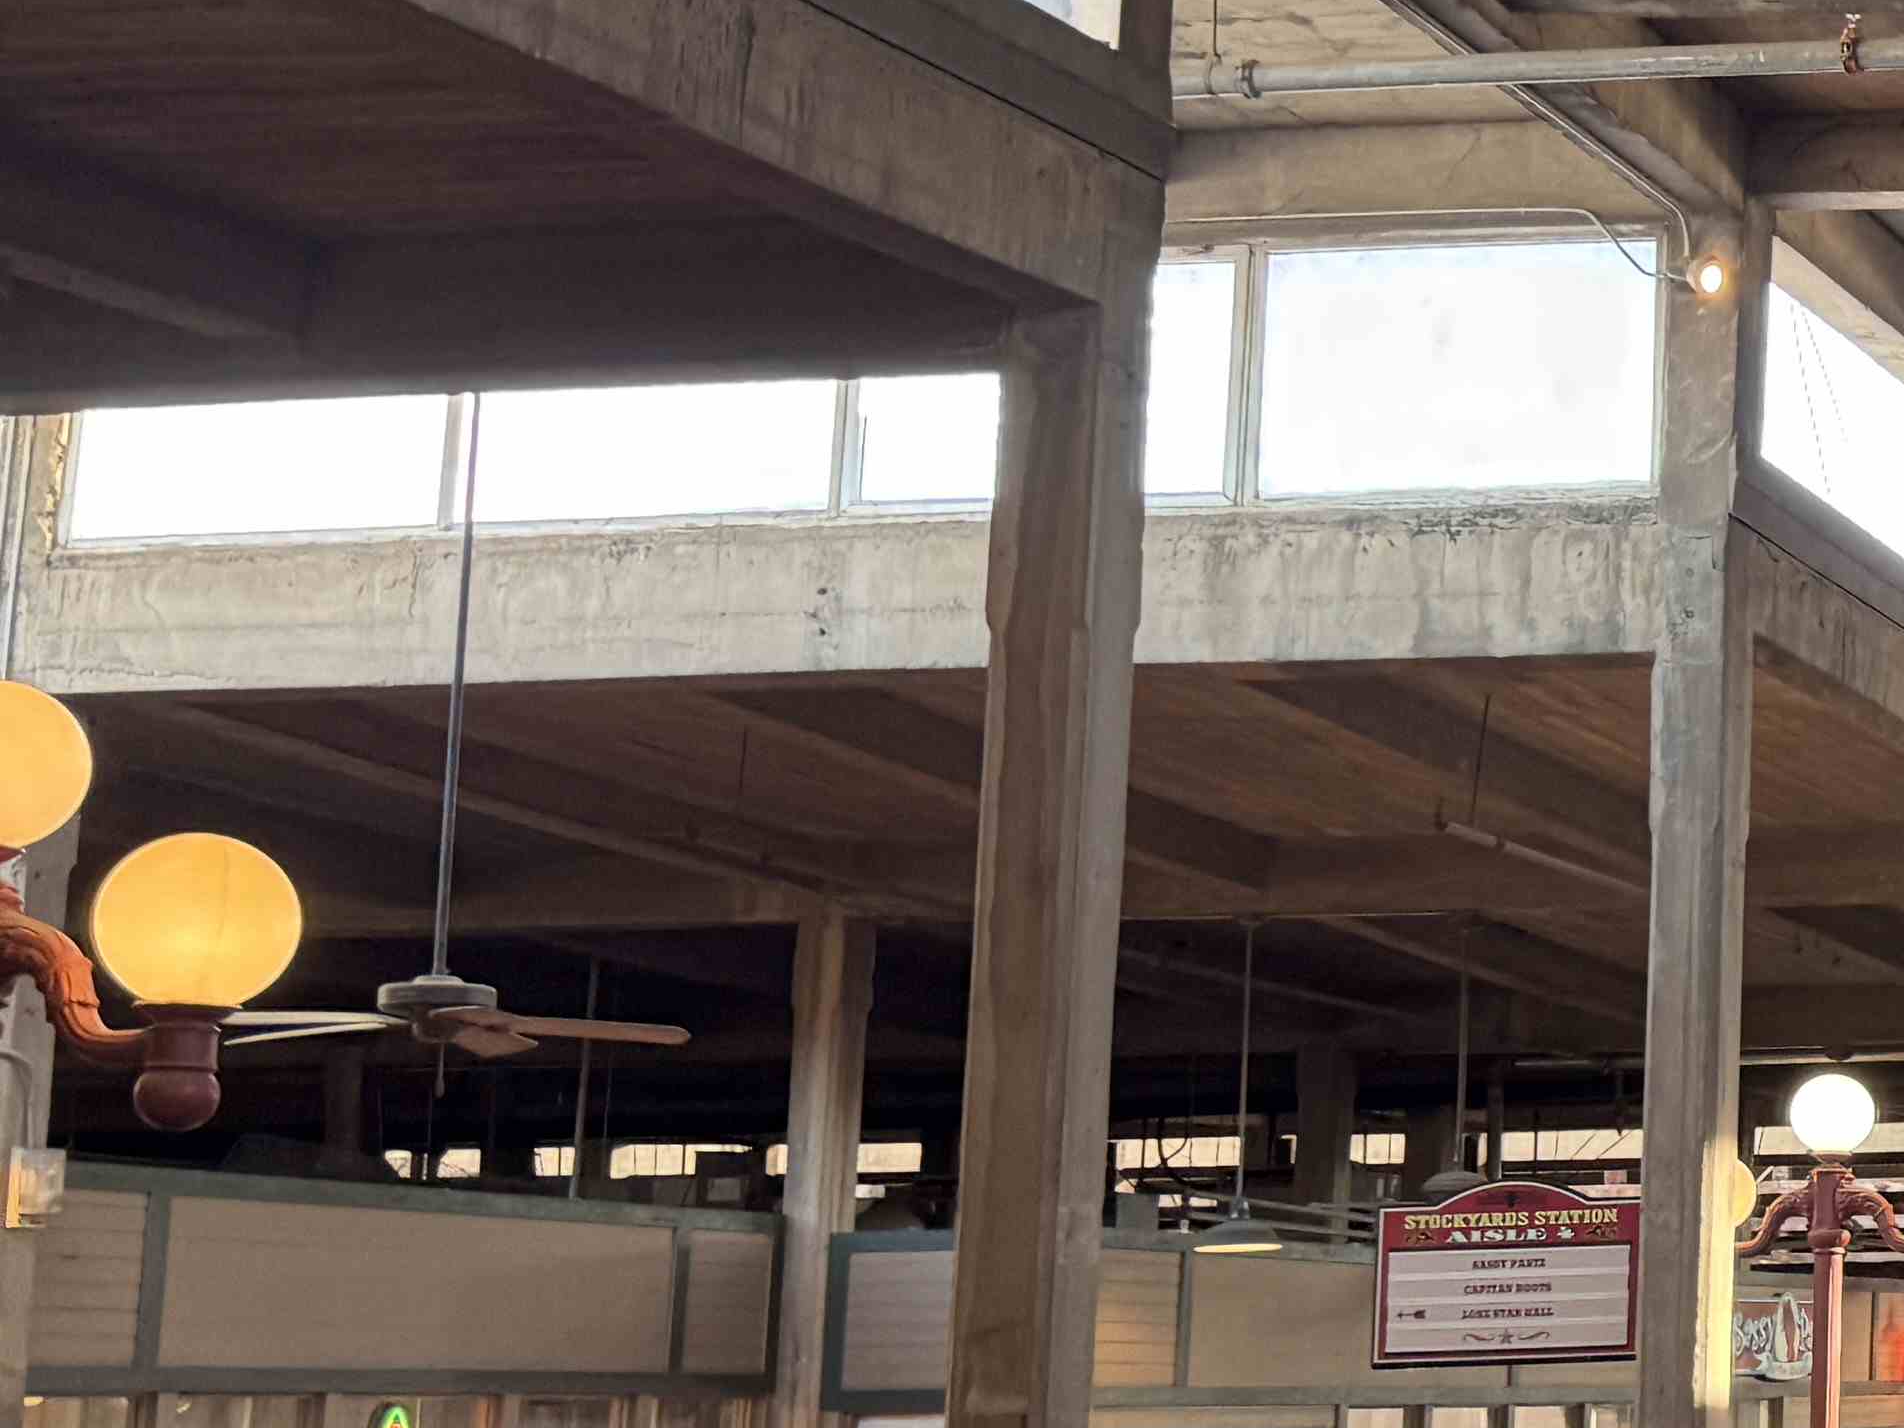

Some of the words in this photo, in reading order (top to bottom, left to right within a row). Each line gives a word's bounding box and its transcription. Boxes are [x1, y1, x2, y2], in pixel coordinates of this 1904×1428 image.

[1405, 1212, 1529, 1230] STOCKYARDS
[1534, 1208, 1619, 1225] STATION
[1446, 1227, 1547, 1243] AISLE
